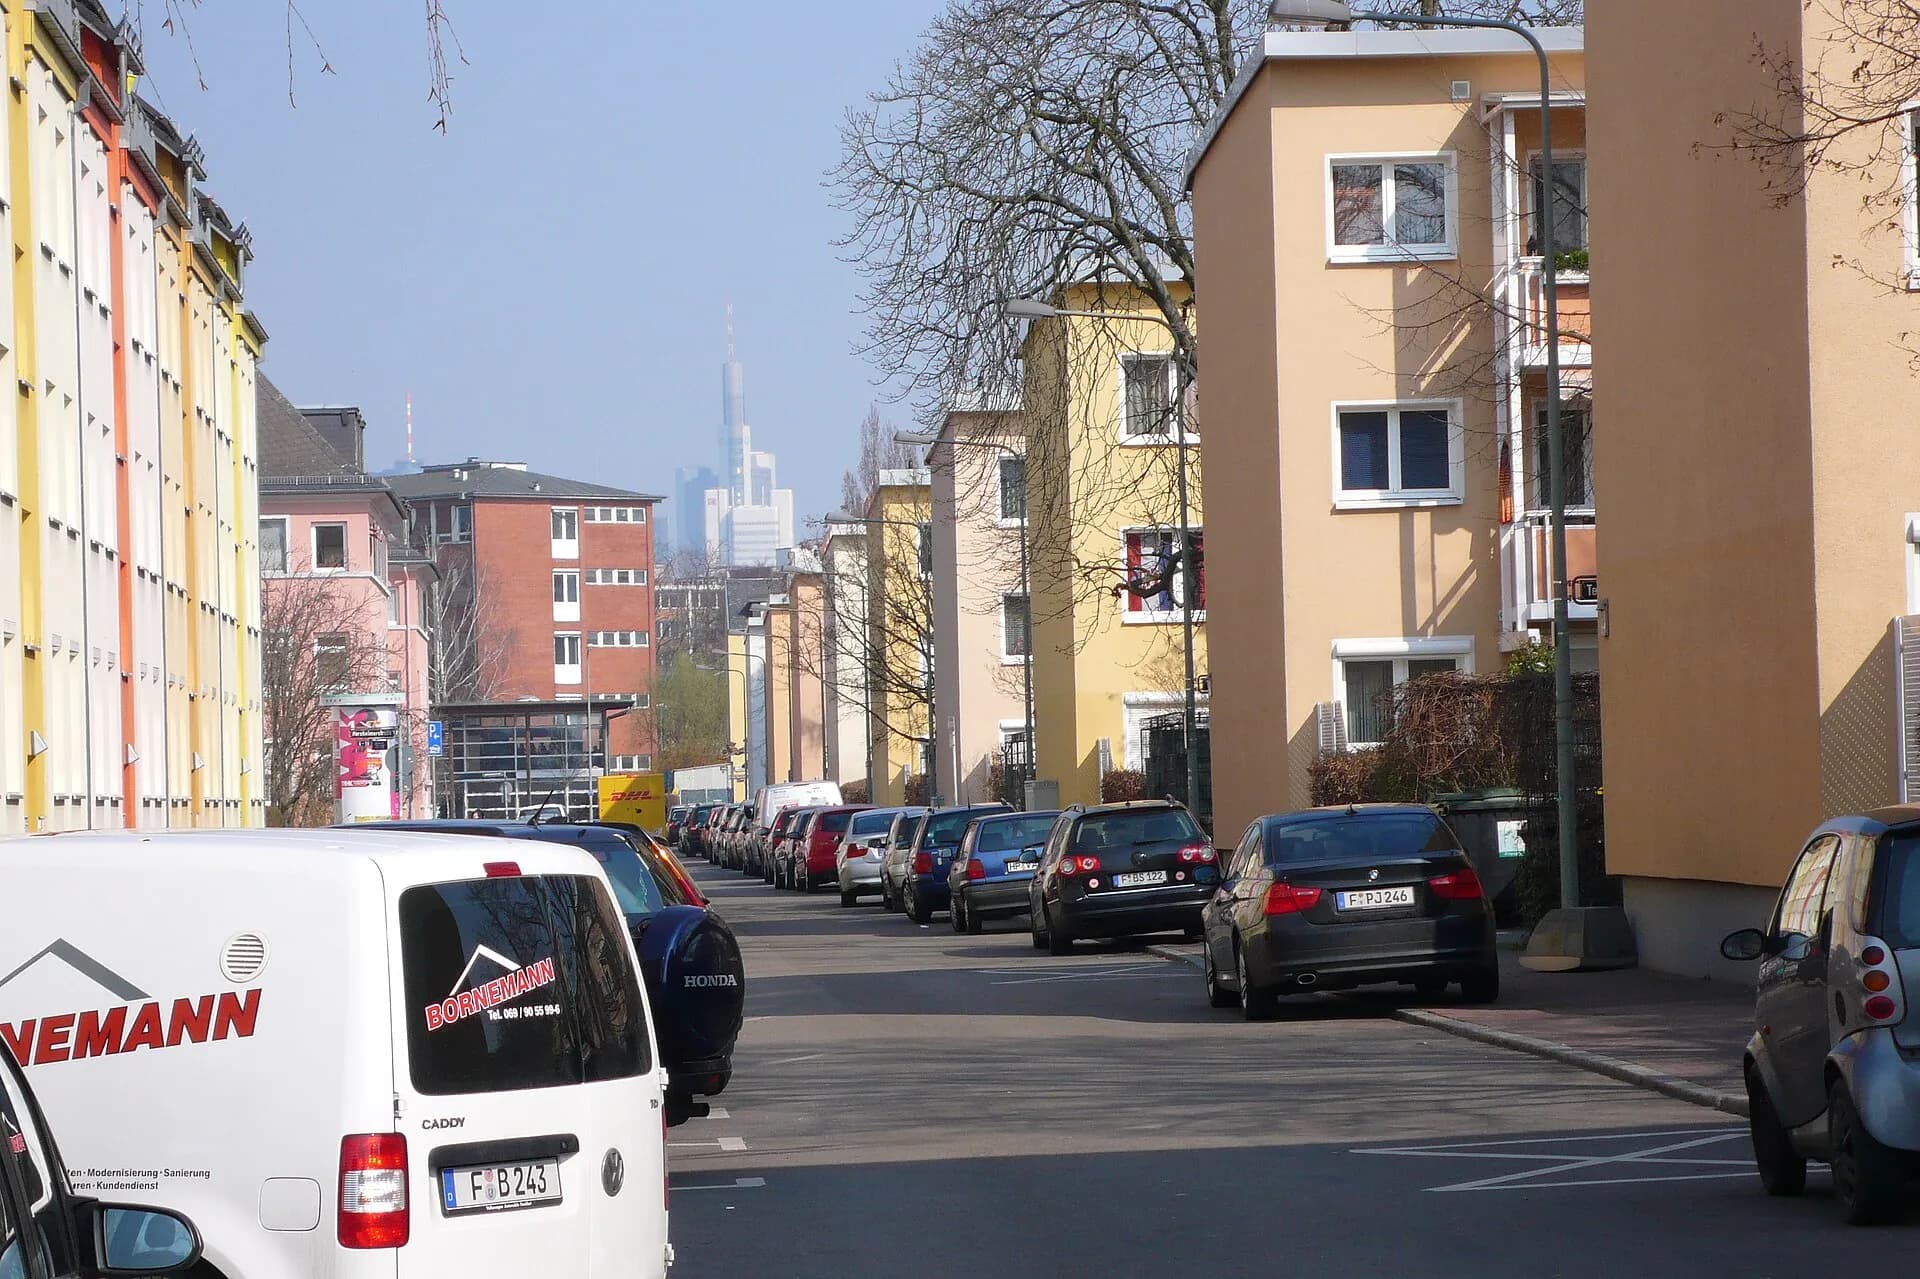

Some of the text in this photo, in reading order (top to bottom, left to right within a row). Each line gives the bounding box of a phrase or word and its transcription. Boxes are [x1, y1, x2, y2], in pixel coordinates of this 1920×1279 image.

[429, 723, 436, 738] P
[611, 790, 652, 801] DHL
[1121, 874, 1127, 884] F
[1349, 893, 1357, 906] F
[683, 974, 738, 988] HONDA
[425, 957, 556, 1031] BORNEMANN
[503, 1007, 519, 1019] 069
[524, 1006, 534, 1017] 90
[422, 1117, 465, 1130] CADDY
[87, 1168, 158, 1179] Modernisierung
[163, 1168, 211, 1179] Sanierung
[96, 1181, 159, 1190] Kundendienst
[470, 1171, 483, 1201] F
